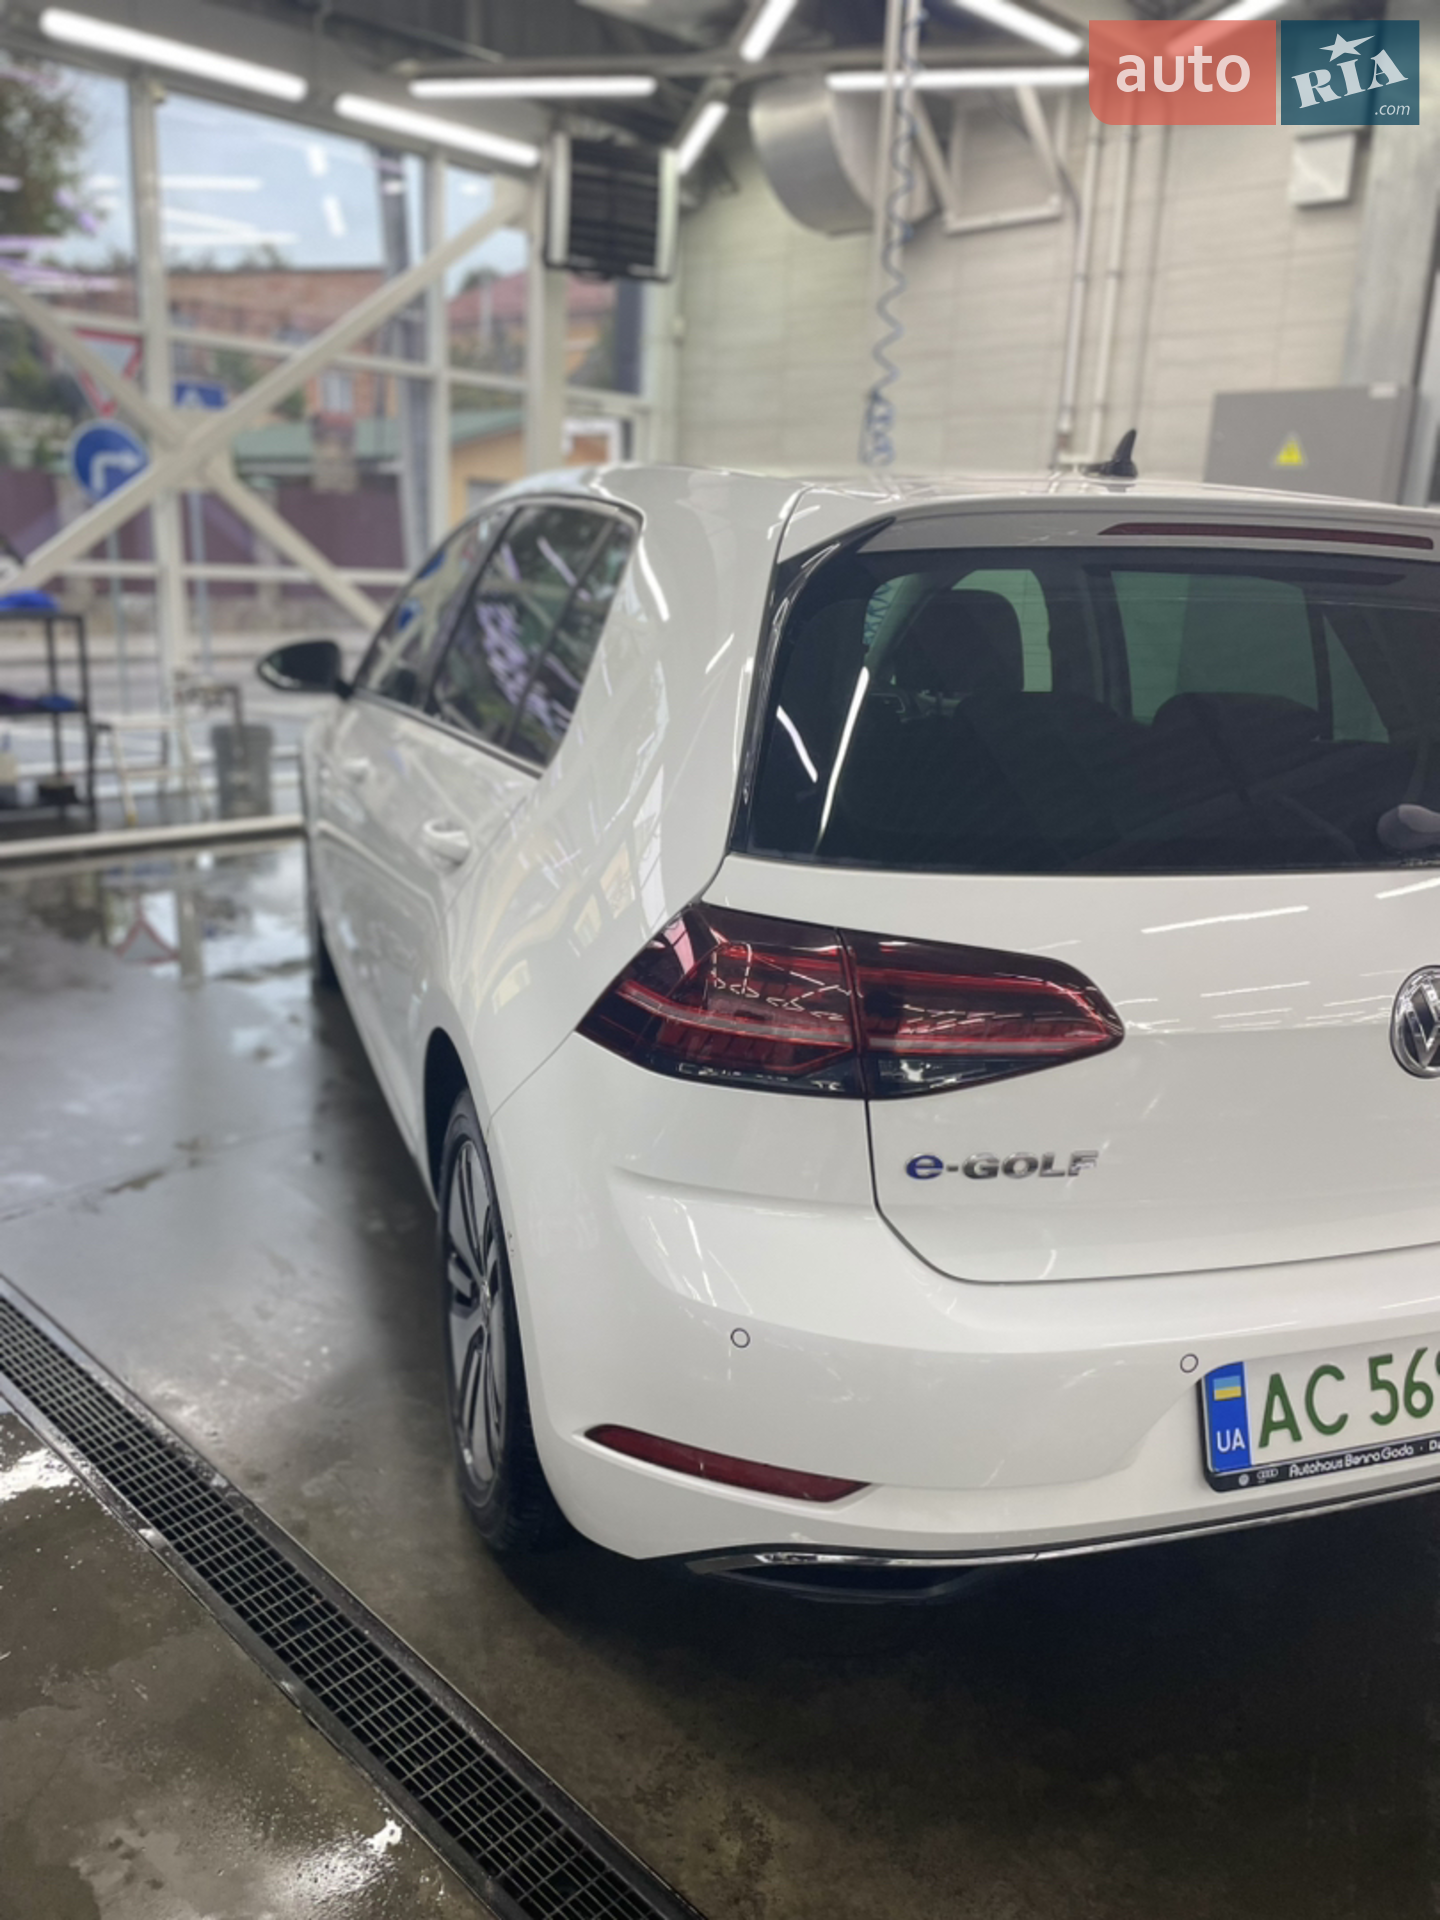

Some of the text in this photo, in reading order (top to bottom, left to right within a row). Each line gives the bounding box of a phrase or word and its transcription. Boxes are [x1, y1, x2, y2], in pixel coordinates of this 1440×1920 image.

[905, 1150, 1099, 1180] e-GOLF
[1258, 1346, 1440, 1448] AC 56
[1216, 1428, 1246, 1453] UA
